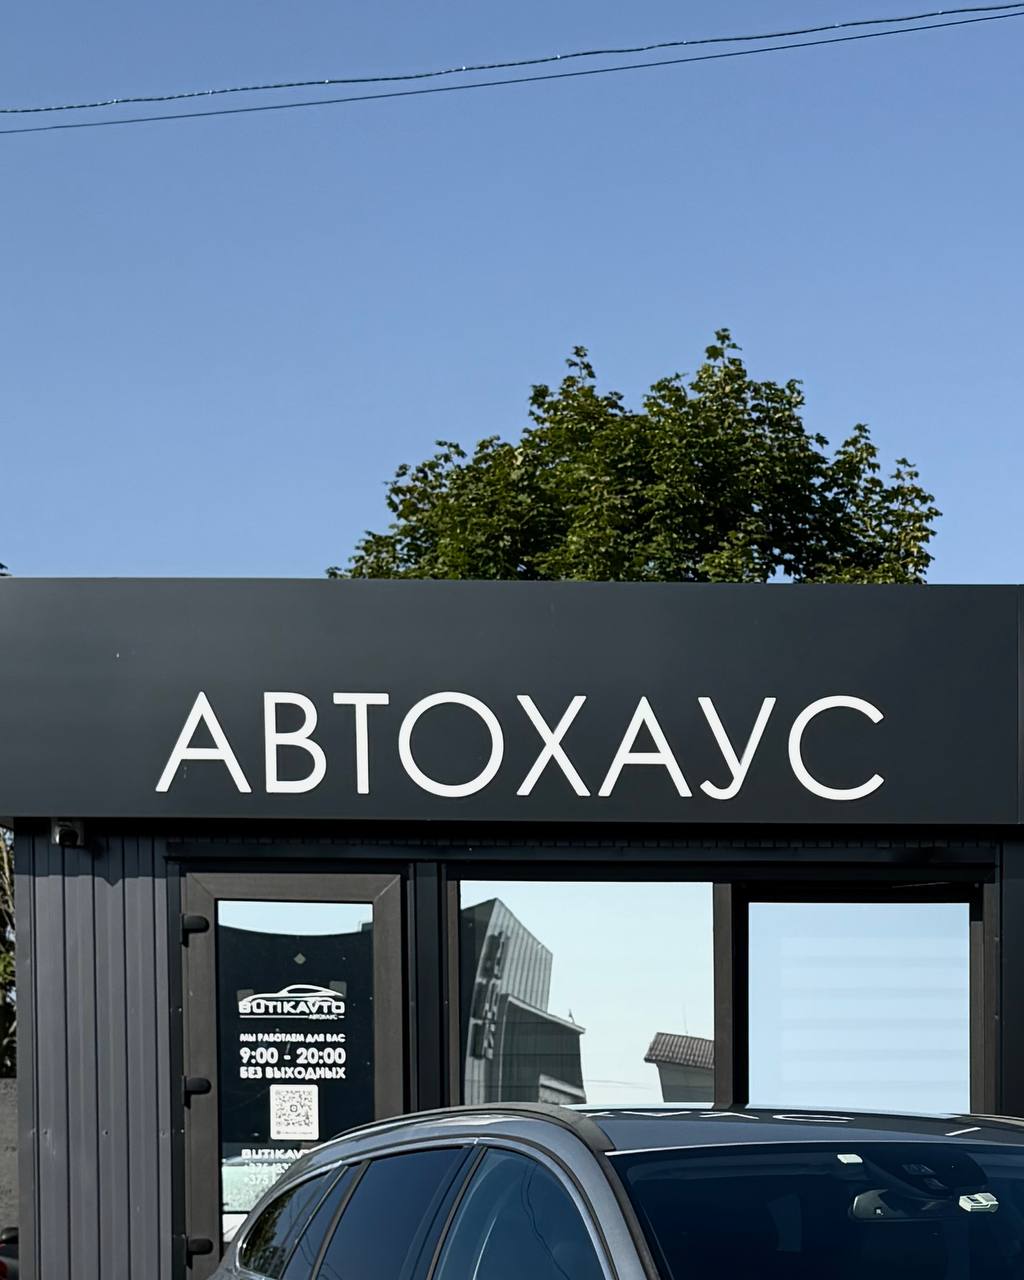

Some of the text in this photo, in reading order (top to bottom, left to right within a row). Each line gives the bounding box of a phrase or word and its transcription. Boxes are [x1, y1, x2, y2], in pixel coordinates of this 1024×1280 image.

[155, 690, 885, 801] АВТОХАУС
[239, 1000, 345, 1014] BUTIKAVTO
[240, 1047, 279, 1064] 9:00
[296, 1047, 346, 1064] 20:00
[240, 1066, 346, 1080] БЕЗ ВЫХОДНЫХ
